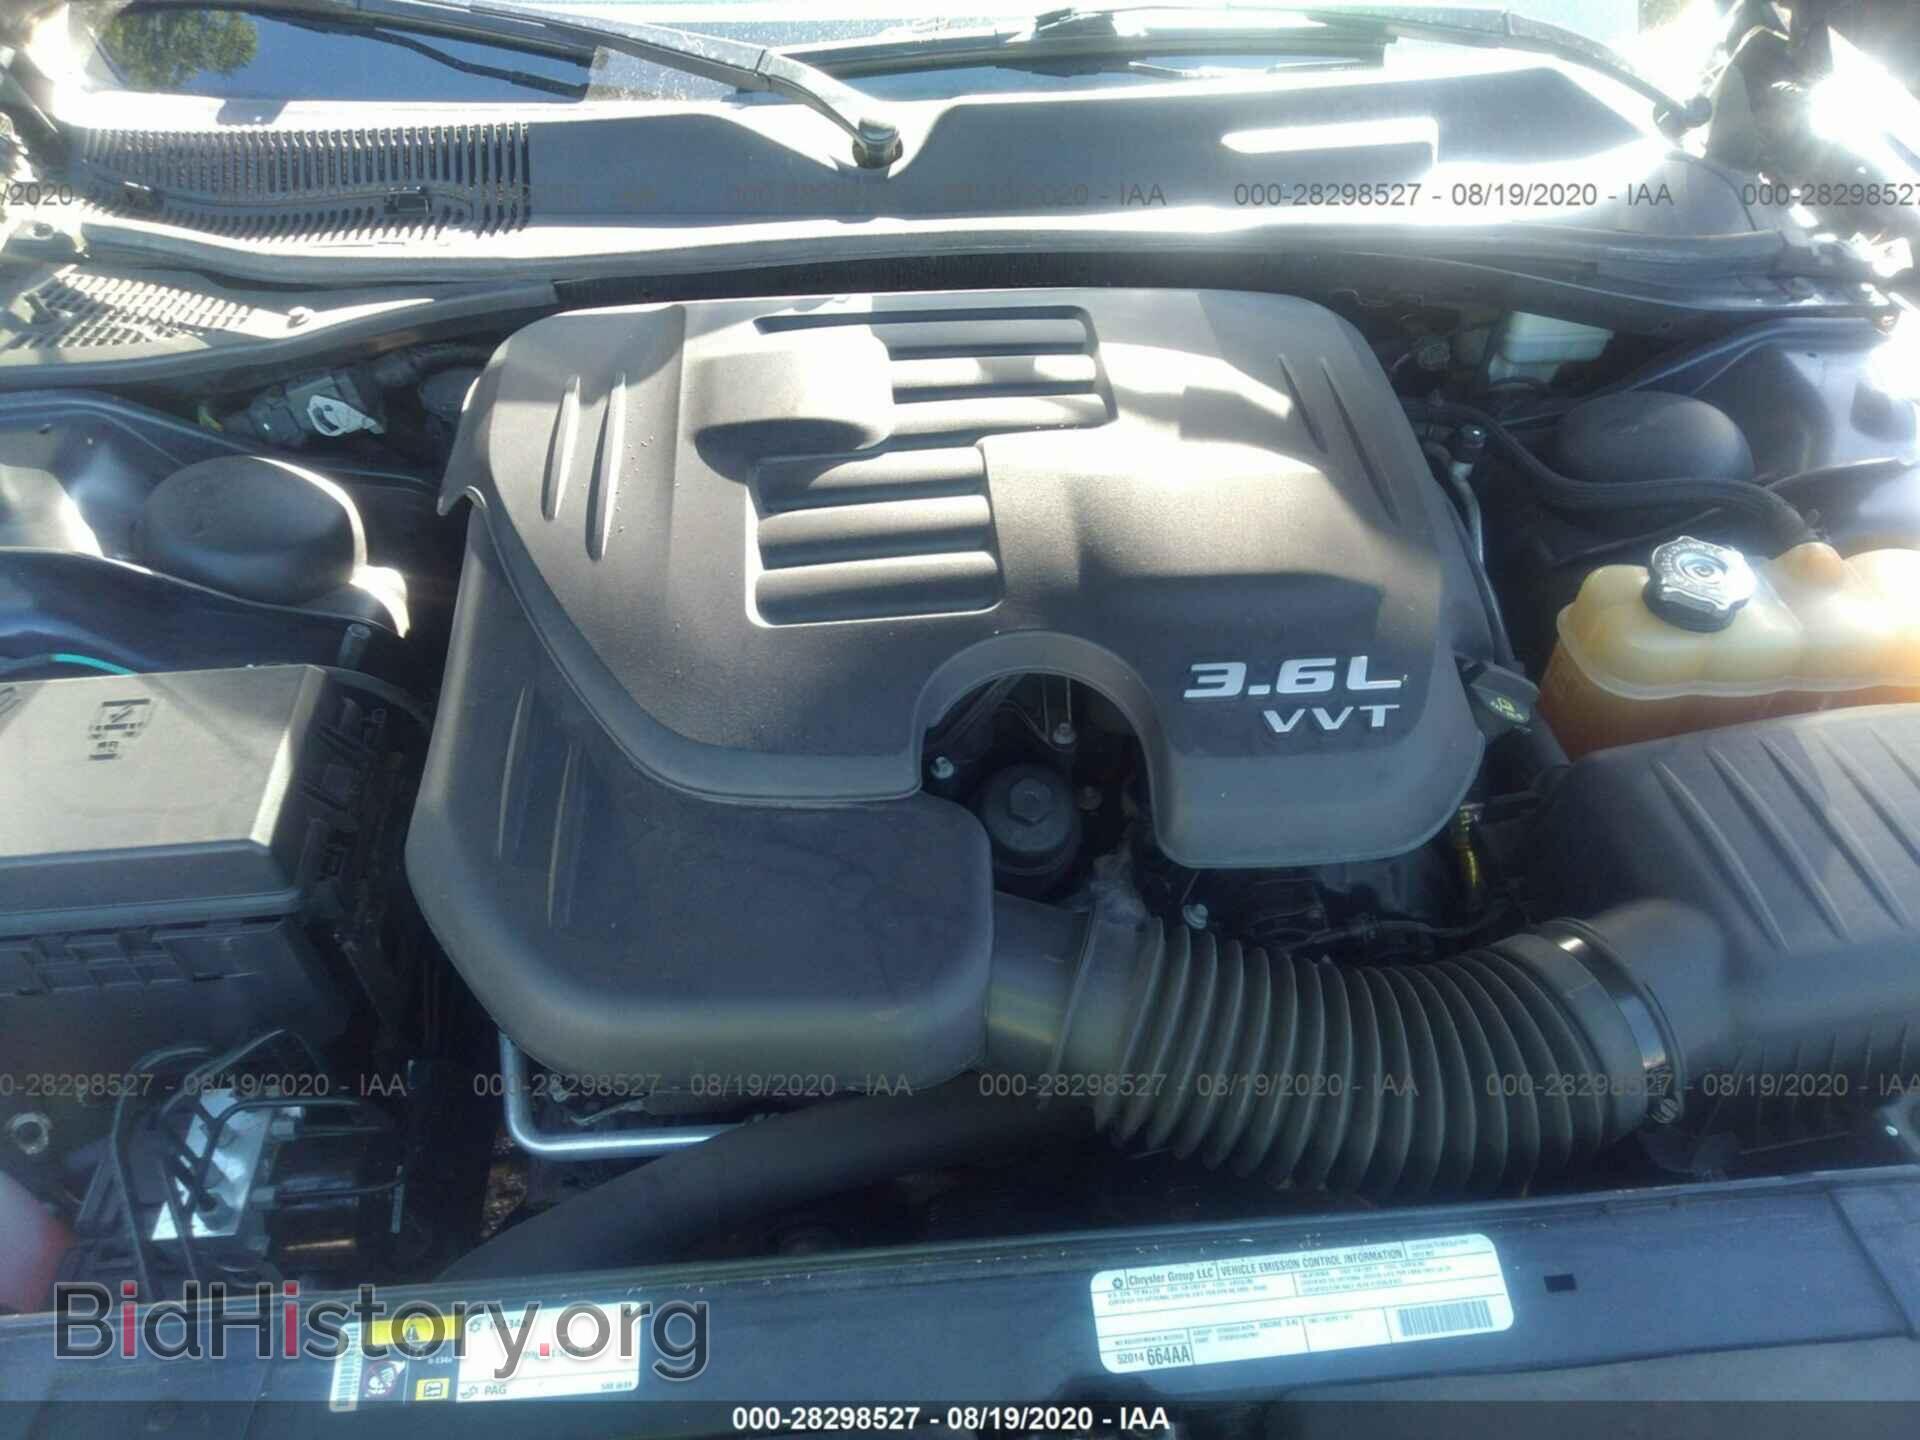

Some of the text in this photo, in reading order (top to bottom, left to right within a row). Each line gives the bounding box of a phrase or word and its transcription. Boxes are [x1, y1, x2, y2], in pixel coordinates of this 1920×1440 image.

[1183, 655, 1402, 698] 3.6L
[1263, 703, 1400, 733] VVT
[1128, 1273, 1165, 1287] Chrysler
[1168, 1269, 1195, 1282] Group
[1197, 1267, 1214, 1279] LLC
[1220, 1261, 1257, 1277] VEHICLE
[1259, 1257, 1300, 1274] EMISSION
[1303, 1254, 1342, 1268] CONTROL
[1344, 1249, 1402, 1265] INFORMATION
[1147, 1345, 1190, 1366] 664AA
[484, 1385, 507, 1396] PAG
